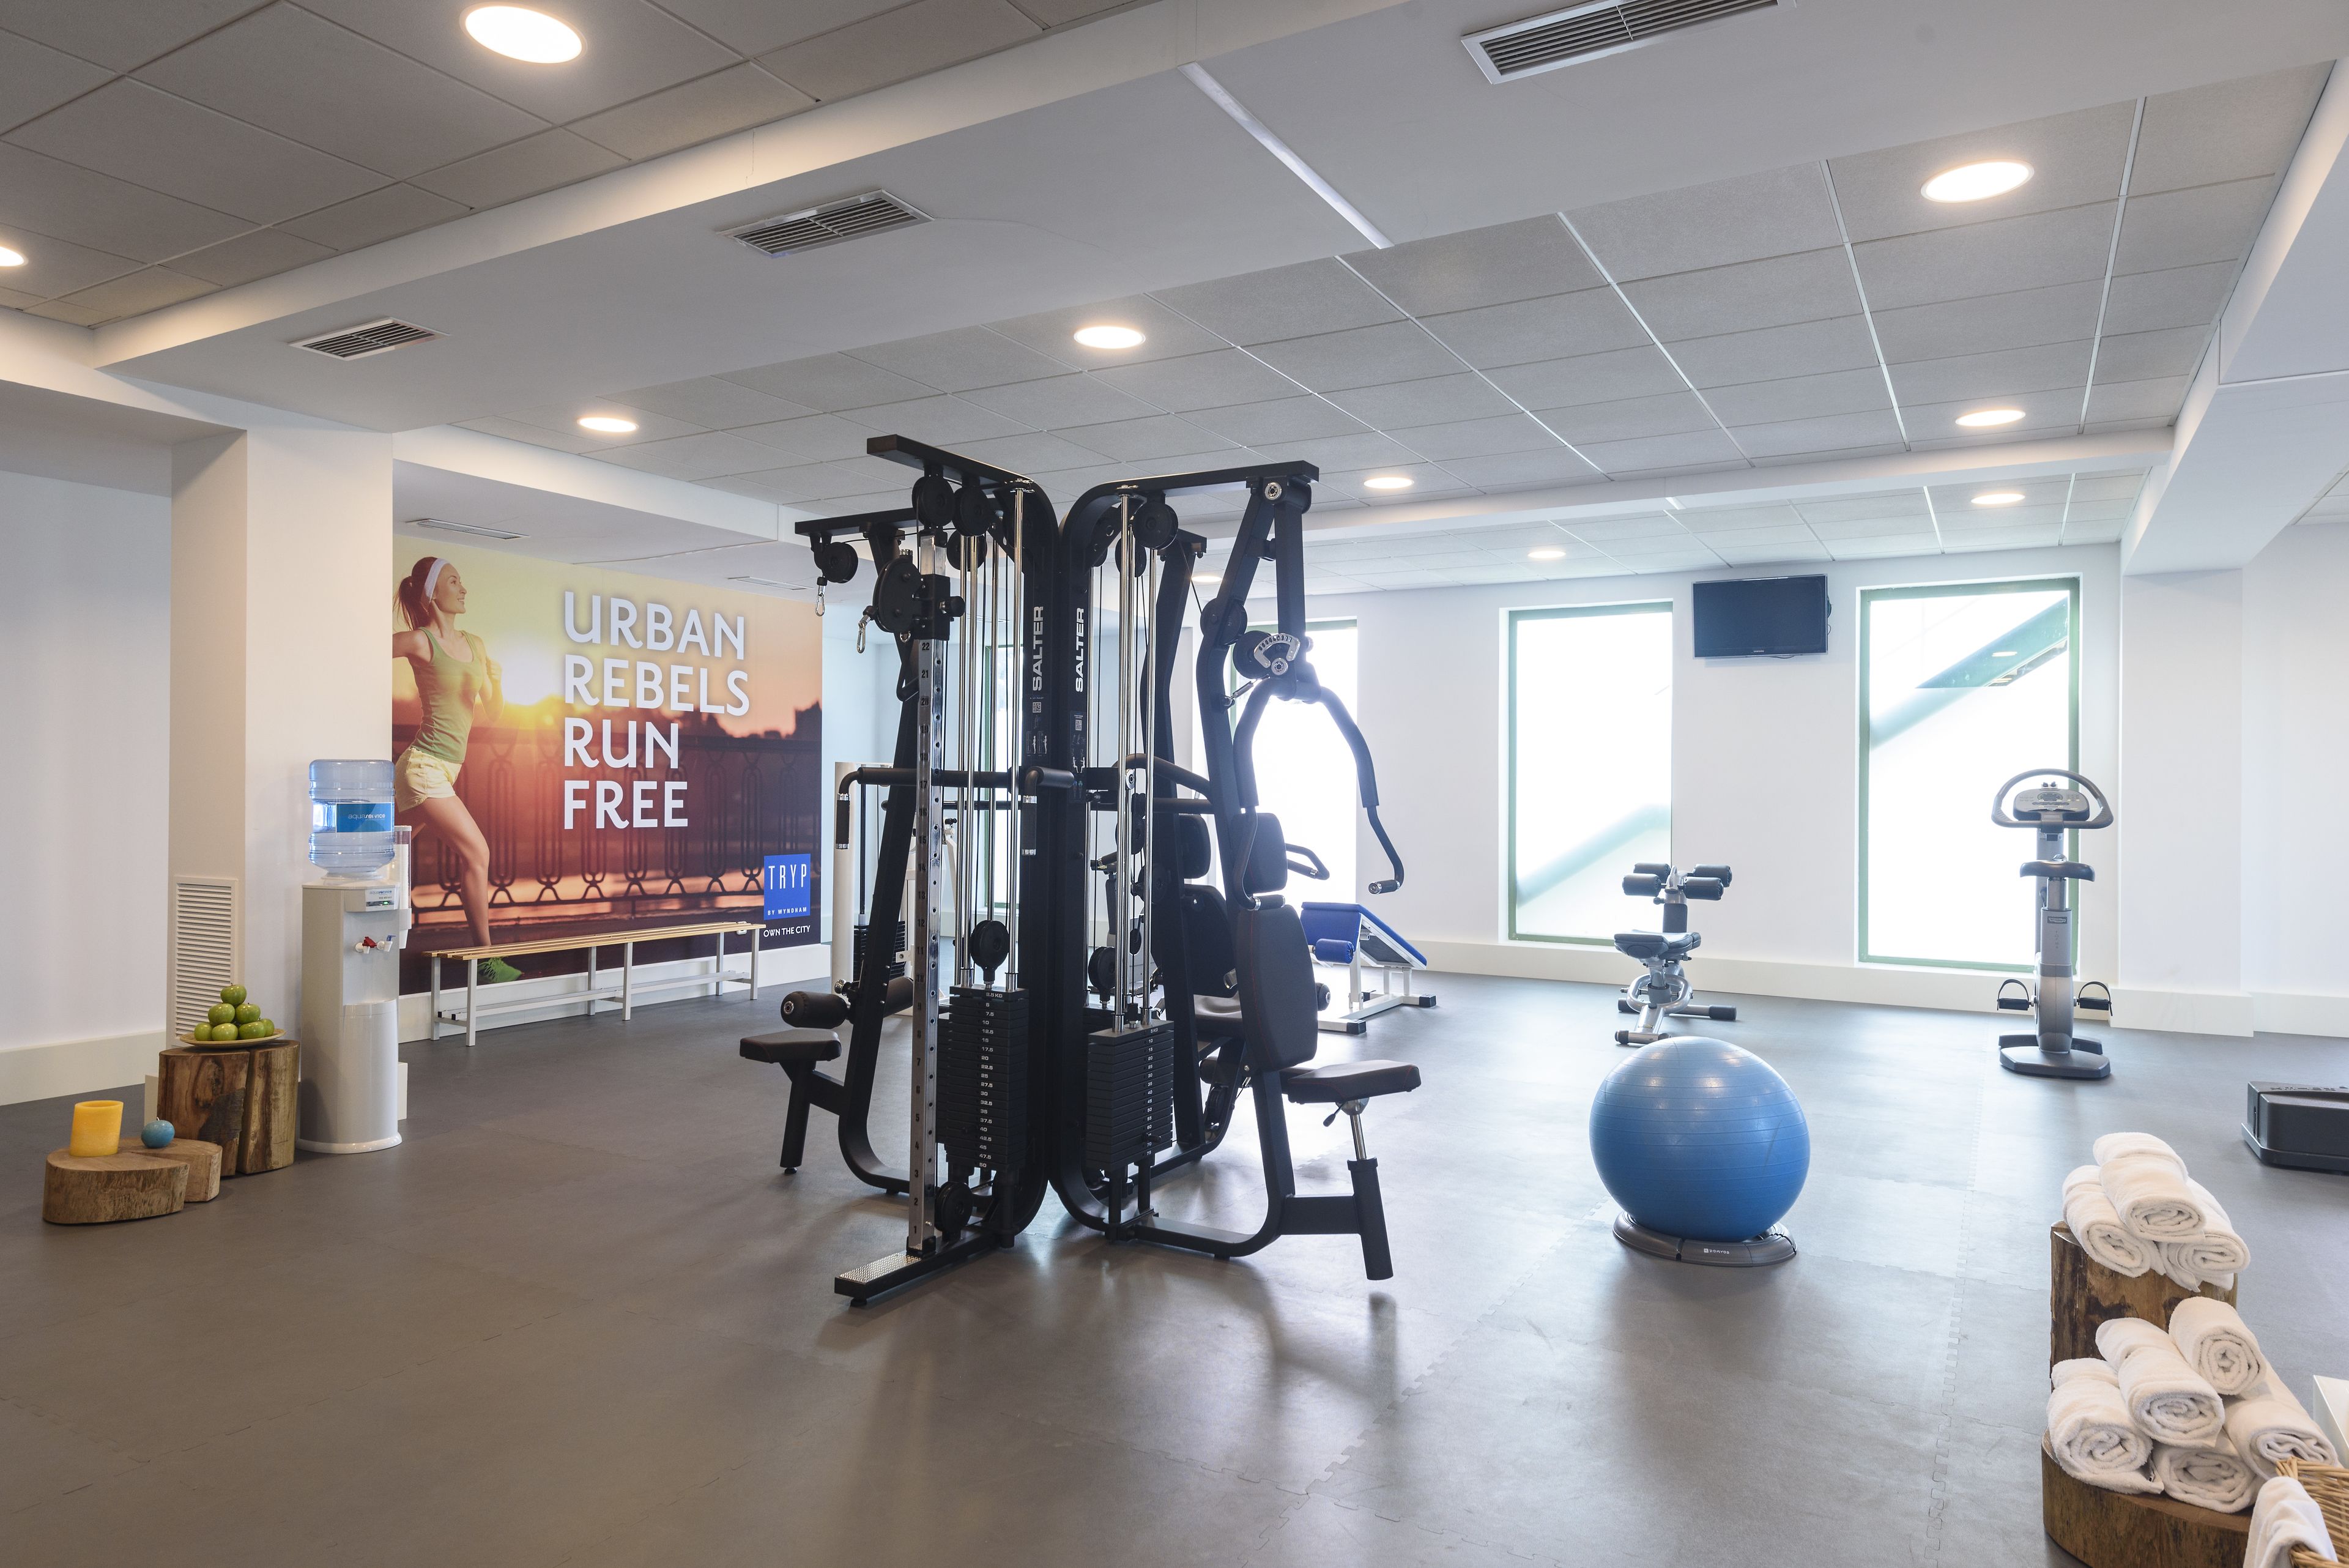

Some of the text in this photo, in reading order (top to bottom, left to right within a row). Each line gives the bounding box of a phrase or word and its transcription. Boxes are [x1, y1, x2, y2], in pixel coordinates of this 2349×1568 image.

[565, 591, 744, 660] URBAN
[1033, 606, 1044, 691] SALTER
[1075, 608, 1084, 693] SALTER
[565, 654, 749, 716] REBELS
[565, 717, 678, 769] RUN
[564, 780, 688, 830] FREE
[768, 863, 807, 890] TRYP
[763, 925, 811, 937] OWN THE CITY
